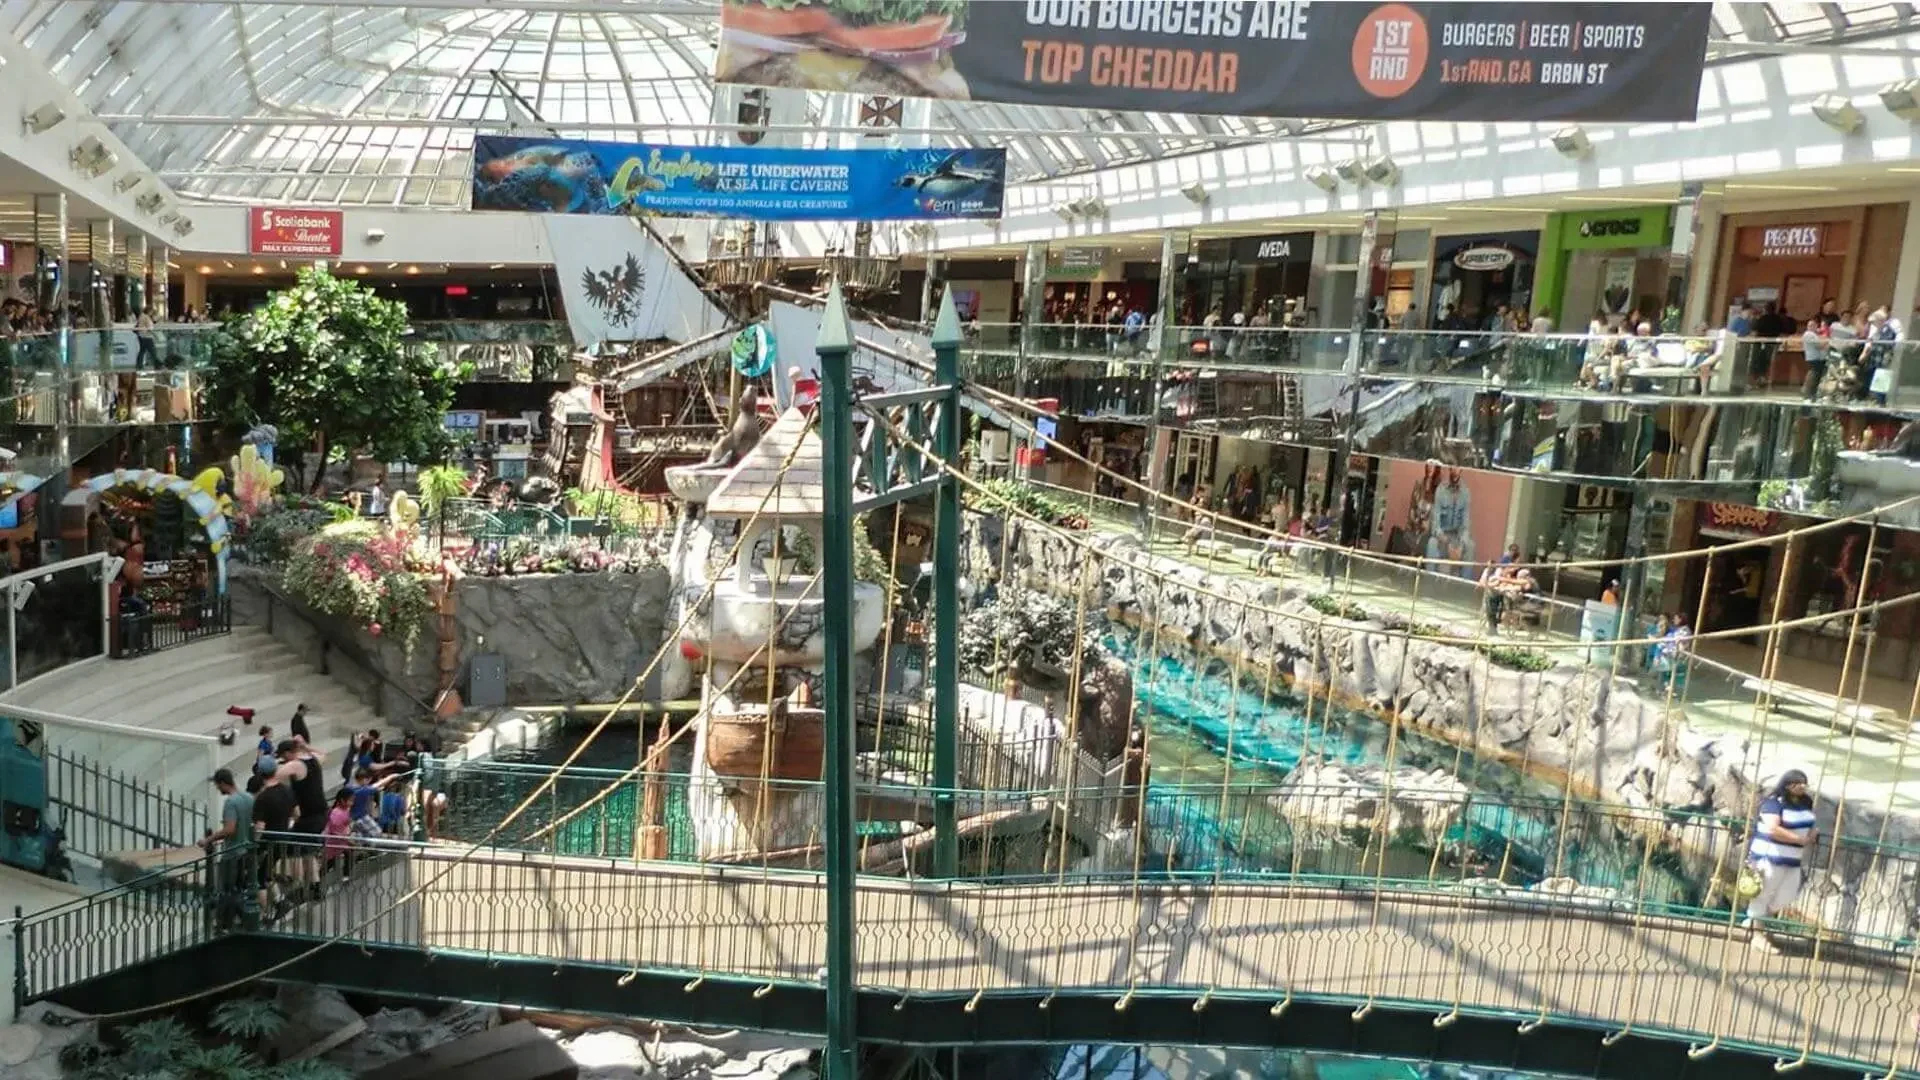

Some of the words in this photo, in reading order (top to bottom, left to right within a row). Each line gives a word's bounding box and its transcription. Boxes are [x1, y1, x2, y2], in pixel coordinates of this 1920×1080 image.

[1097, 1, 1243, 37] BURGERS
[1247, 1, 1311, 40] ARE
[1372, 20, 1413, 54] 1ST
[1442, 22, 1516, 47] BURGERS
[1529, 23, 1571, 48] BEER
[1583, 24, 1645, 49] SPORTS
[1021, 40, 1085, 84] TOP
[1090, 44, 1240, 94] CHEDDAR
[1369, 55, 1409, 80] RND
[1540, 62, 1585, 84] BRBN
[1586, 63, 1609, 84] ST
[717, 162, 749, 177] LIFE
[751, 163, 850, 179] UNDERWATER
[715, 178, 733, 190] AT
[734, 178, 759, 191] SEA
[761, 179, 788, 192] LIFE
[789, 179, 850, 193] CAVERNS
[645, 195, 693, 206] FEATURING
[694, 197, 719, 207] OVER
[735, 199, 774, 209] ANIMALS
[782, 199, 798, 209] SEA
[799, 199, 849, 210] CREATURES
[275, 214, 332, 229] Scotiabank
[293, 228, 332, 243] Theatre
[1763, 226, 1818, 247] PEOPLES
[1256, 240, 1291, 258] AVEDA
